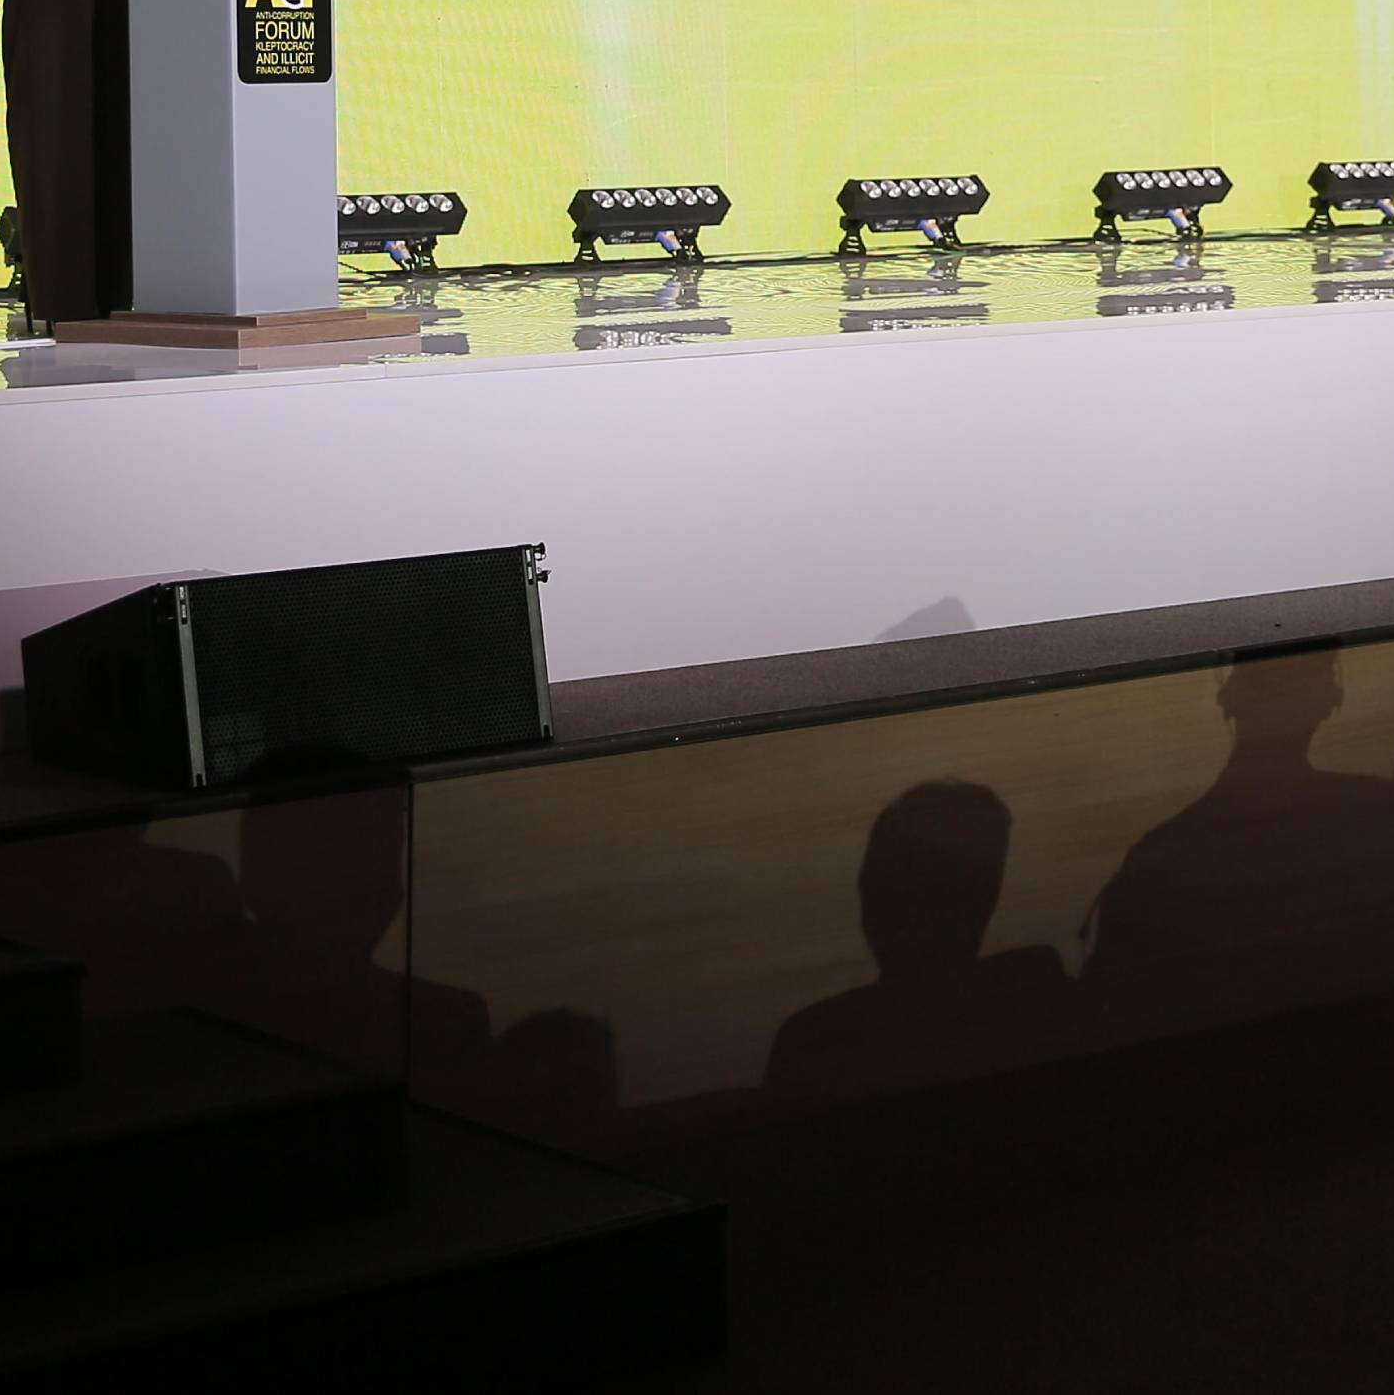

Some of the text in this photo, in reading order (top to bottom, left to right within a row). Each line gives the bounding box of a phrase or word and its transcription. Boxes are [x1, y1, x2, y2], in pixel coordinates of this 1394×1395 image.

[255, 11, 315, 20] ANTI-CORRUPTION
[255, 21, 315, 40] FORUM
[255, 41, 314, 52] KLEPTOCRACY
[256, 52, 315, 65] AND ILLICIT
[256, 66, 315, 75] FINANCIAL FLOWS
